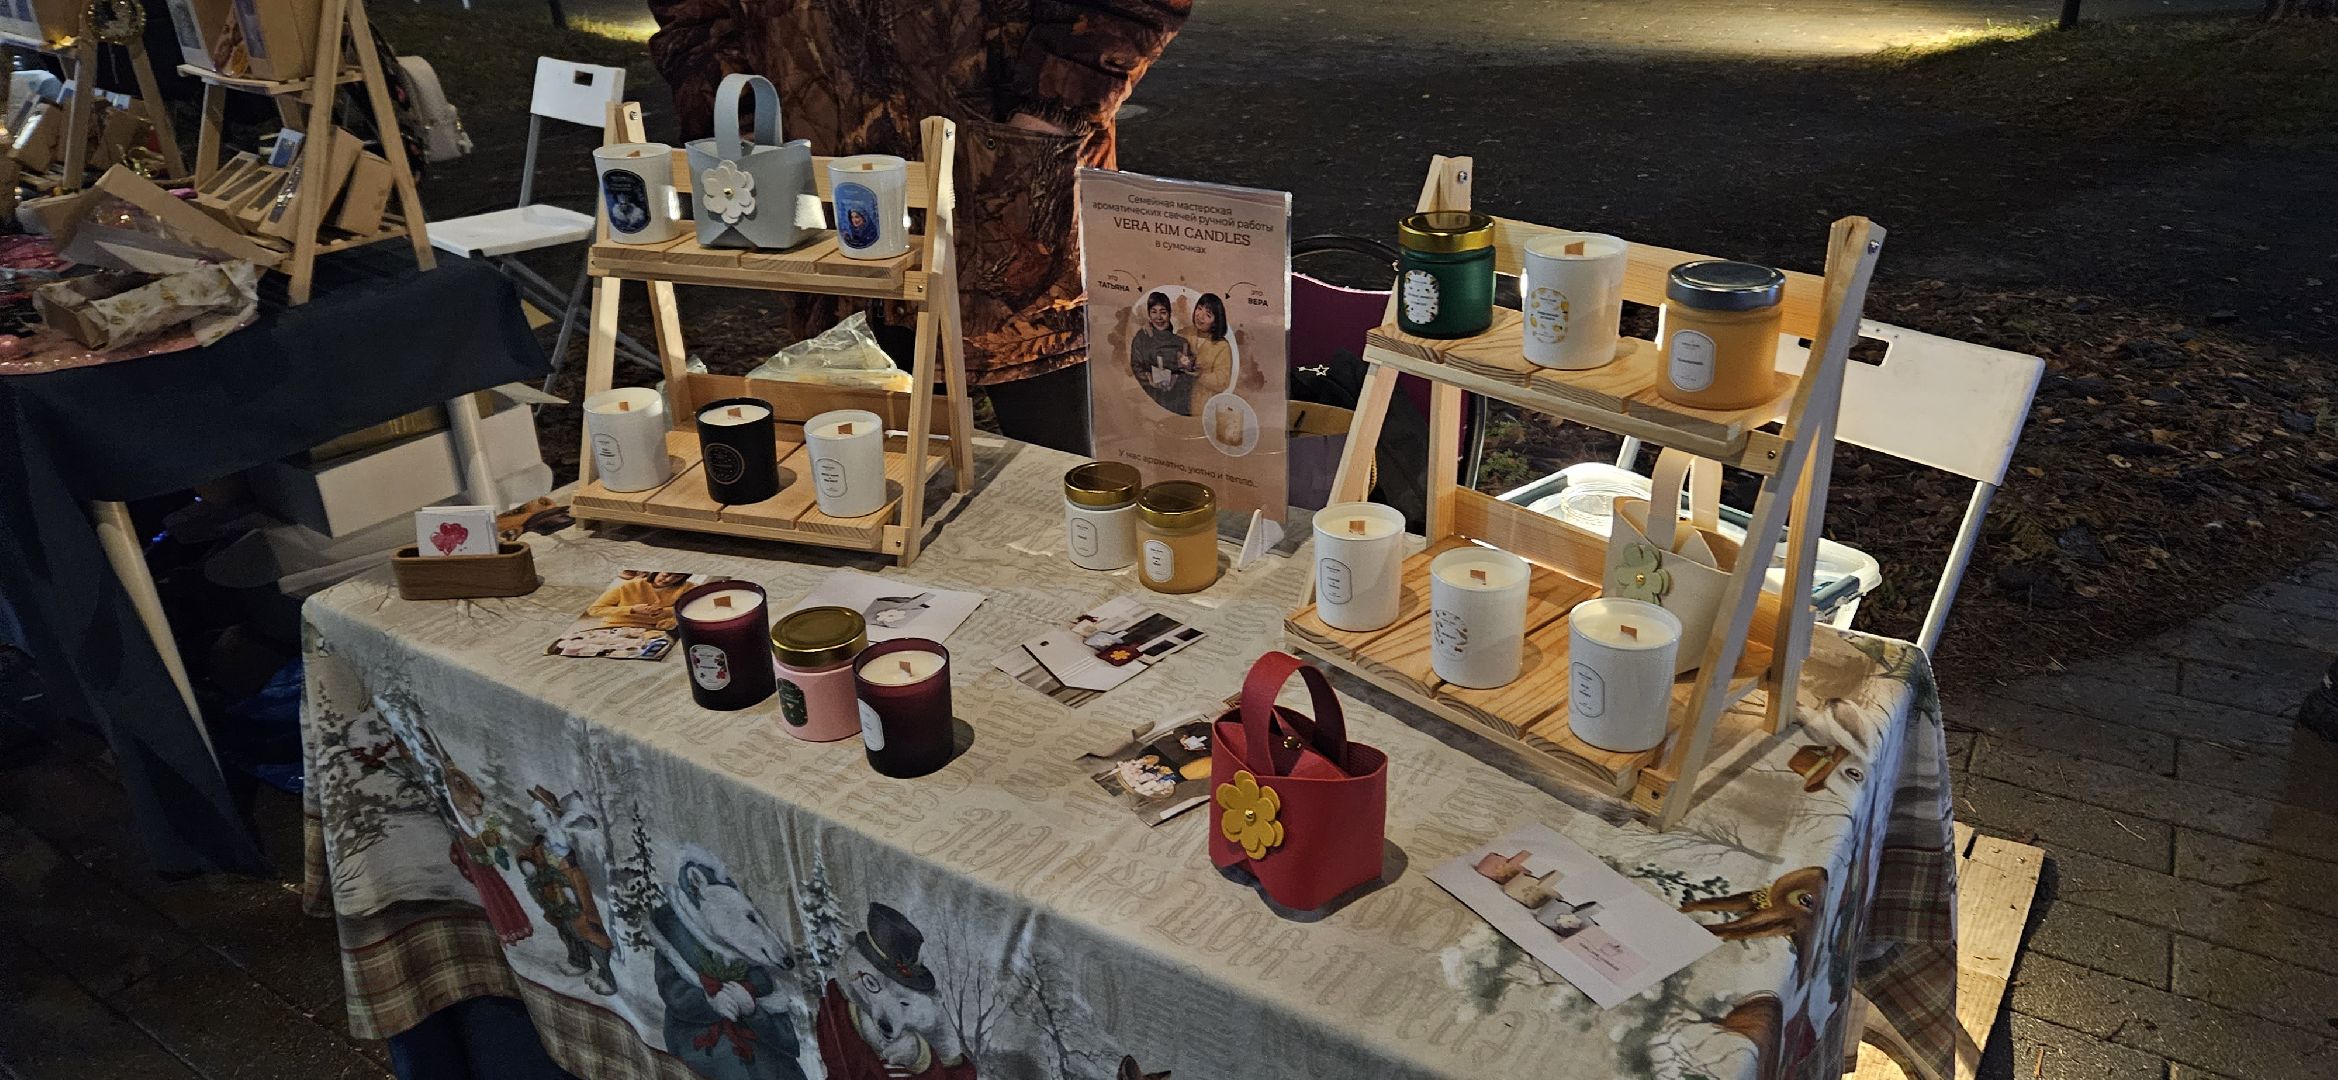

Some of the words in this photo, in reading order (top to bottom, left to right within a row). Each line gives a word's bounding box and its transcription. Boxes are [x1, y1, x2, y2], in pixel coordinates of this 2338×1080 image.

[1127, 194, 1175, 208] Семейная
[1176, 202, 1233, 216] мастерская
[1092, 201, 1161, 217] ароматических
[1163, 211, 1197, 222] свечей
[1198, 216, 1235, 226] ручной
[1236, 219, 1274, 232] работы
[1113, 216, 1150, 233] VERA
[1154, 222, 1180, 237] KIM
[1184, 226, 1250, 247] CANDLES
[1163, 242, 1206, 254] сумочках
[1097, 280, 1130, 292] ТАТЬЯНА
[1247, 297, 1269, 307] ВЕРА
[1187, 466, 1216, 478] уютно
